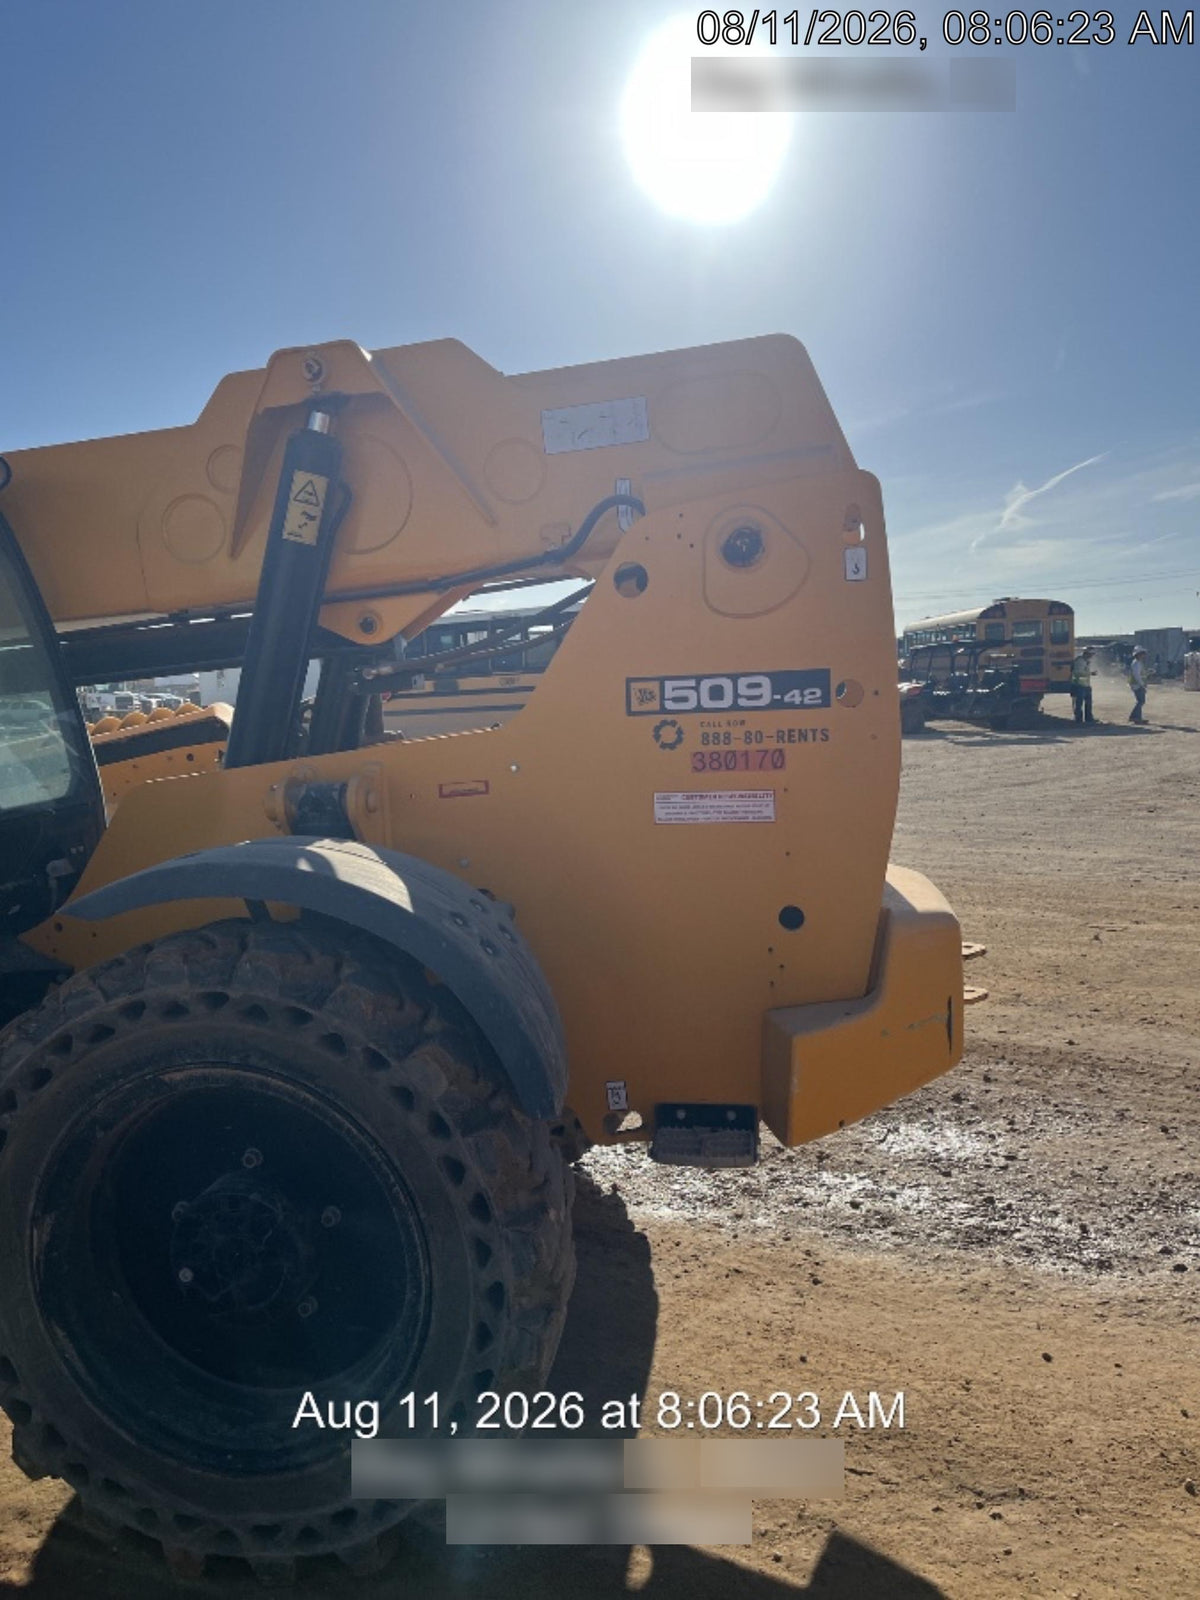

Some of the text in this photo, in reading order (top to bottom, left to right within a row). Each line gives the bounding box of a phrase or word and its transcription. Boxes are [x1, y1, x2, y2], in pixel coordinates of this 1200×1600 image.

[664, 675, 822, 711] 509-42
[700, 720, 723, 728] CALL
[701, 728, 830, 746] 888-80-RENTS
[692, 748, 786, 772] 380170
